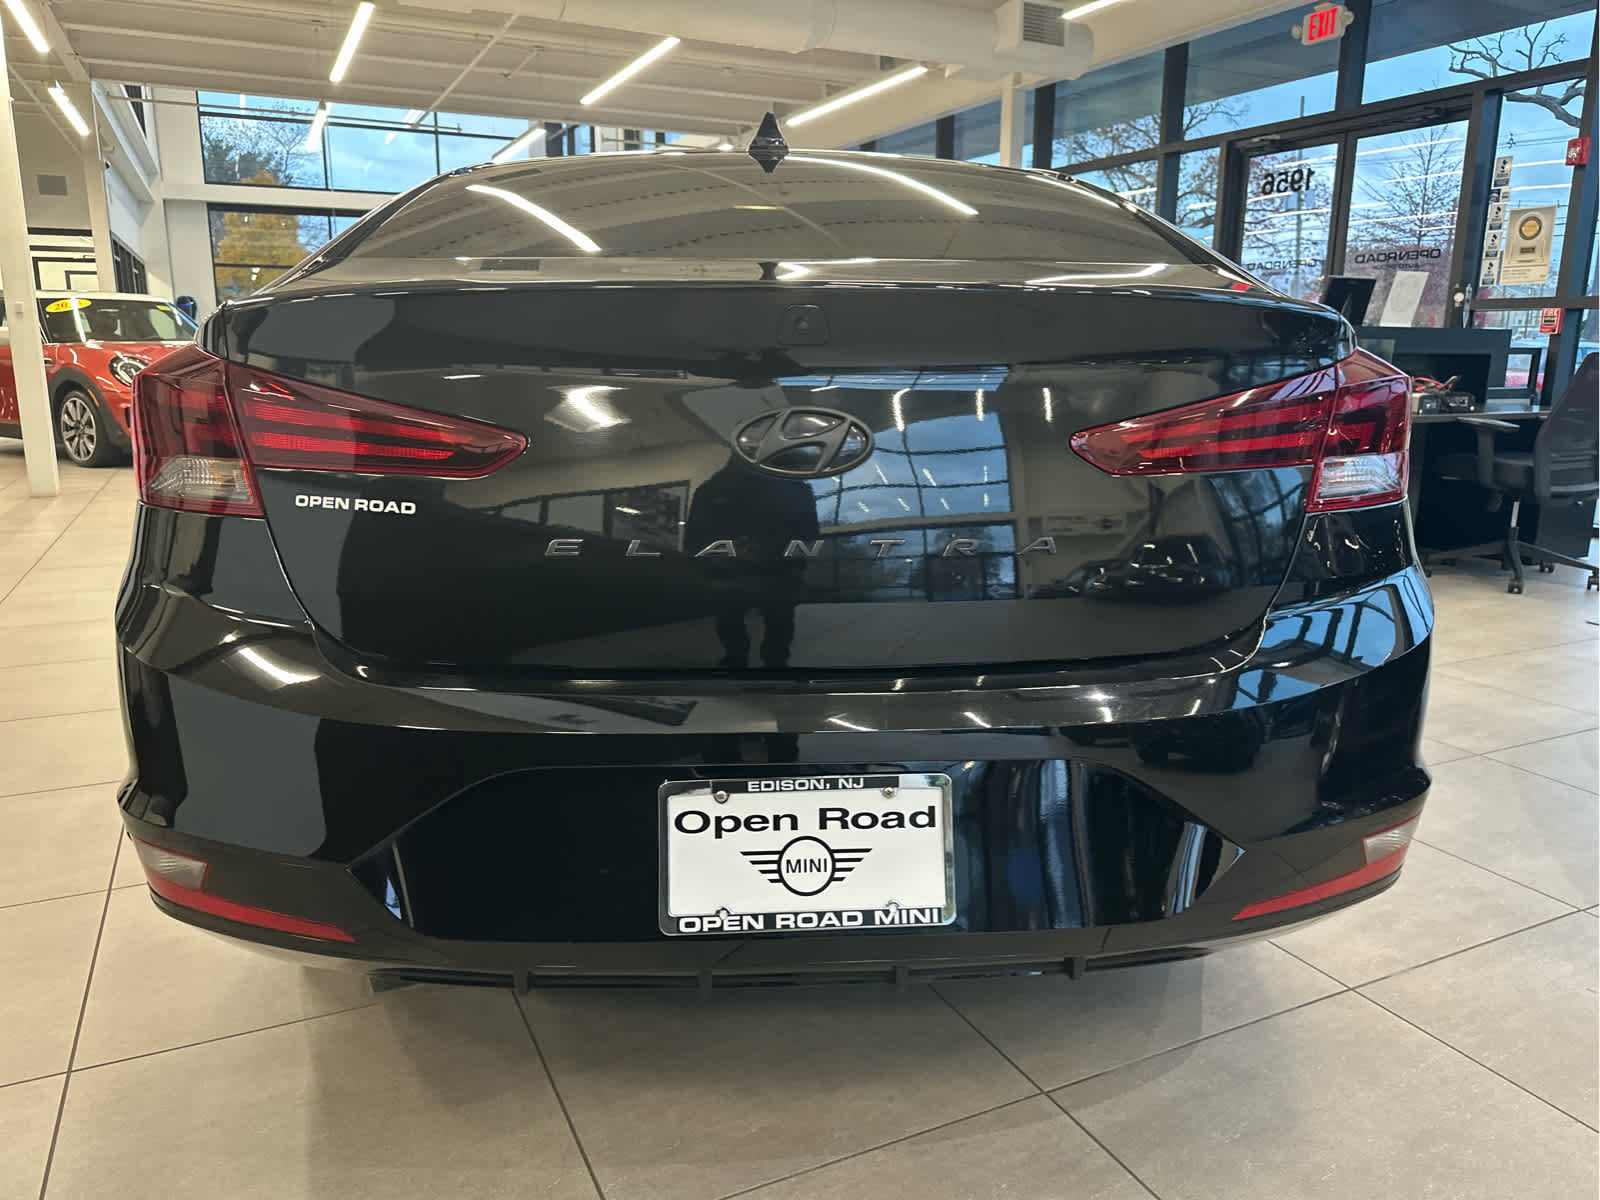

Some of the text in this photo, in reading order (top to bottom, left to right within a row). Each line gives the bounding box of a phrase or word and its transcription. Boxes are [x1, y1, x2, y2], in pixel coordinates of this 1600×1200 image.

[1308, 7, 1339, 41] EXIT
[295, 494, 416, 515] OPEN ROAD
[544, 536, 1057, 559] ELANTRA
[747, 777, 865, 792] EDISON, NJ
[674, 805, 936, 839] Open Road
[785, 858, 828, 874] MINI
[679, 907, 939, 933] OPEN ROAD MINI
